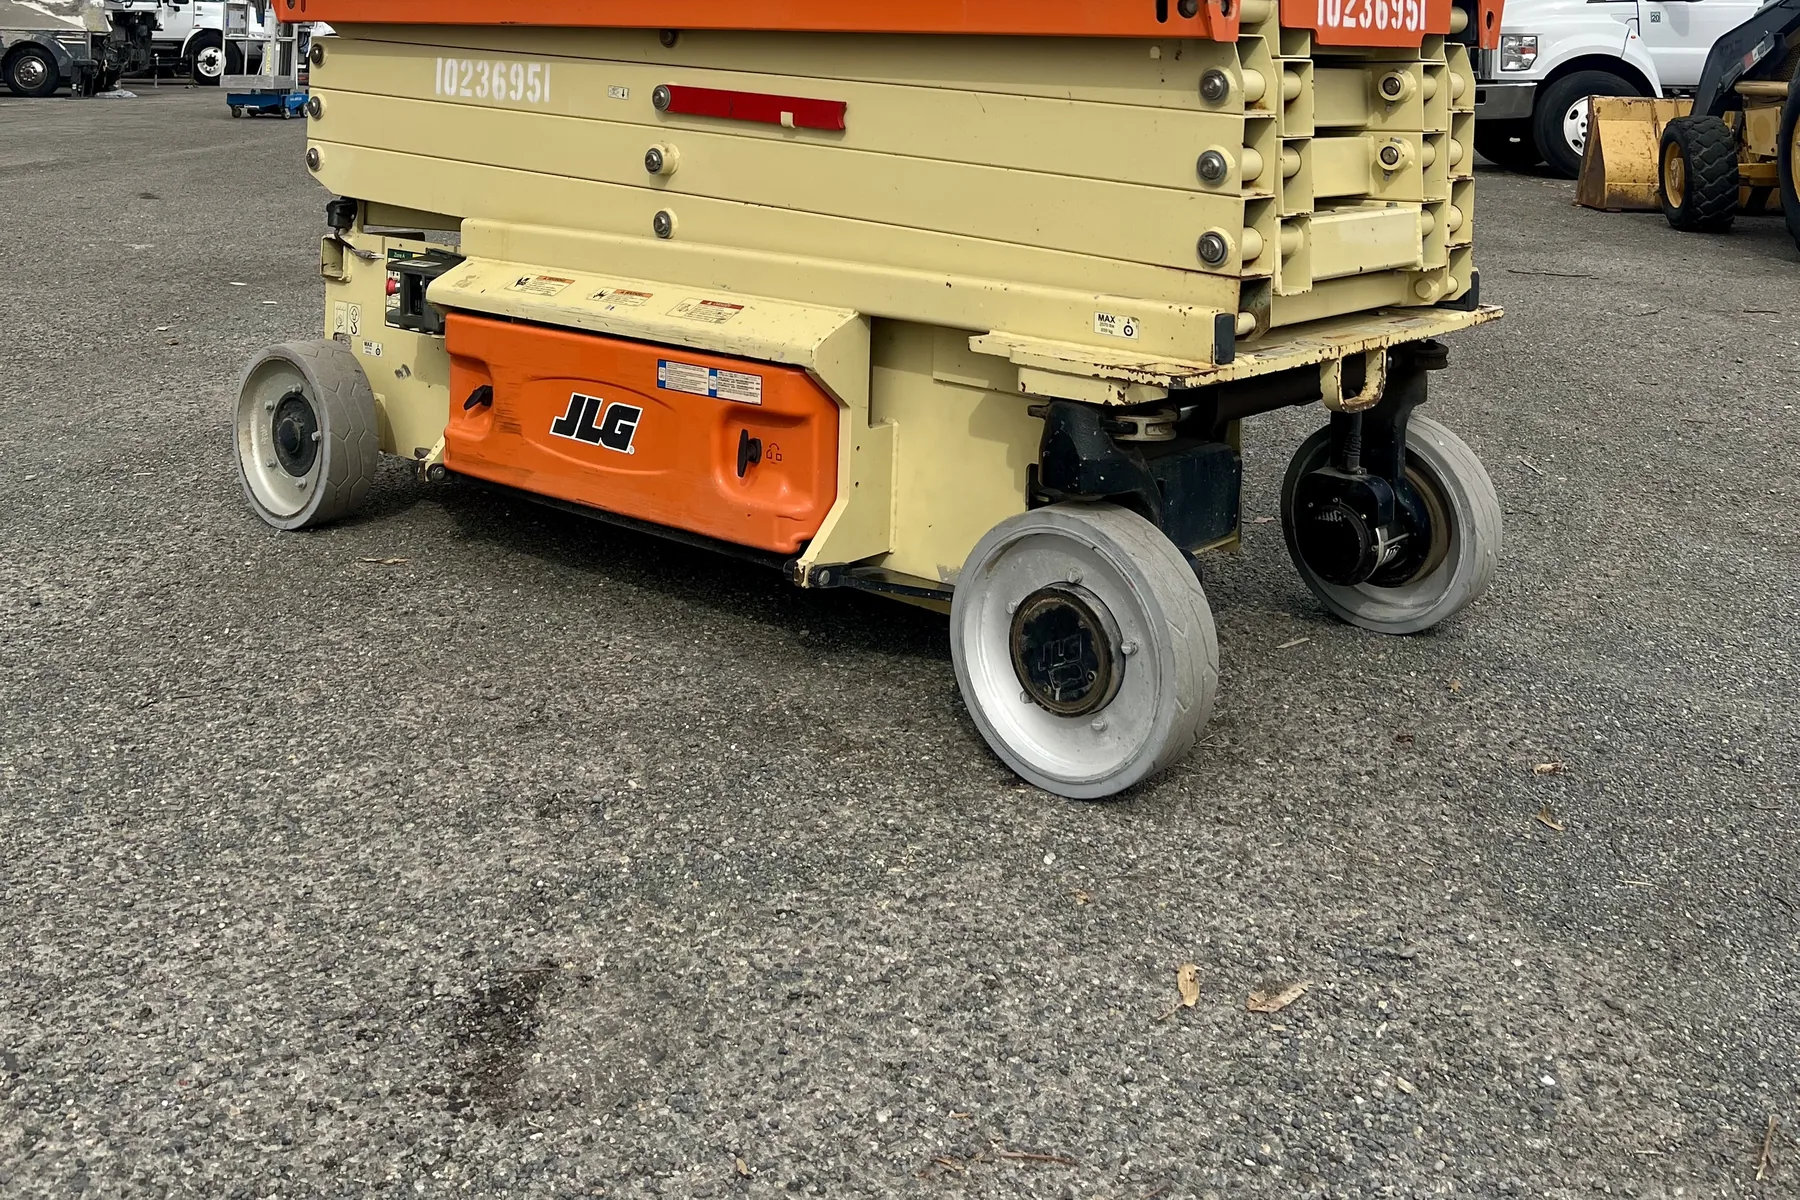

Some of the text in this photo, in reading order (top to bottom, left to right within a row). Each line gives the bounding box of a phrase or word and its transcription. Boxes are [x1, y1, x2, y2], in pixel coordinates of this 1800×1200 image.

[435, 57, 550, 103] 10236951
[1098, 313, 1116, 324] MAX
[549, 391, 644, 454] JLG
